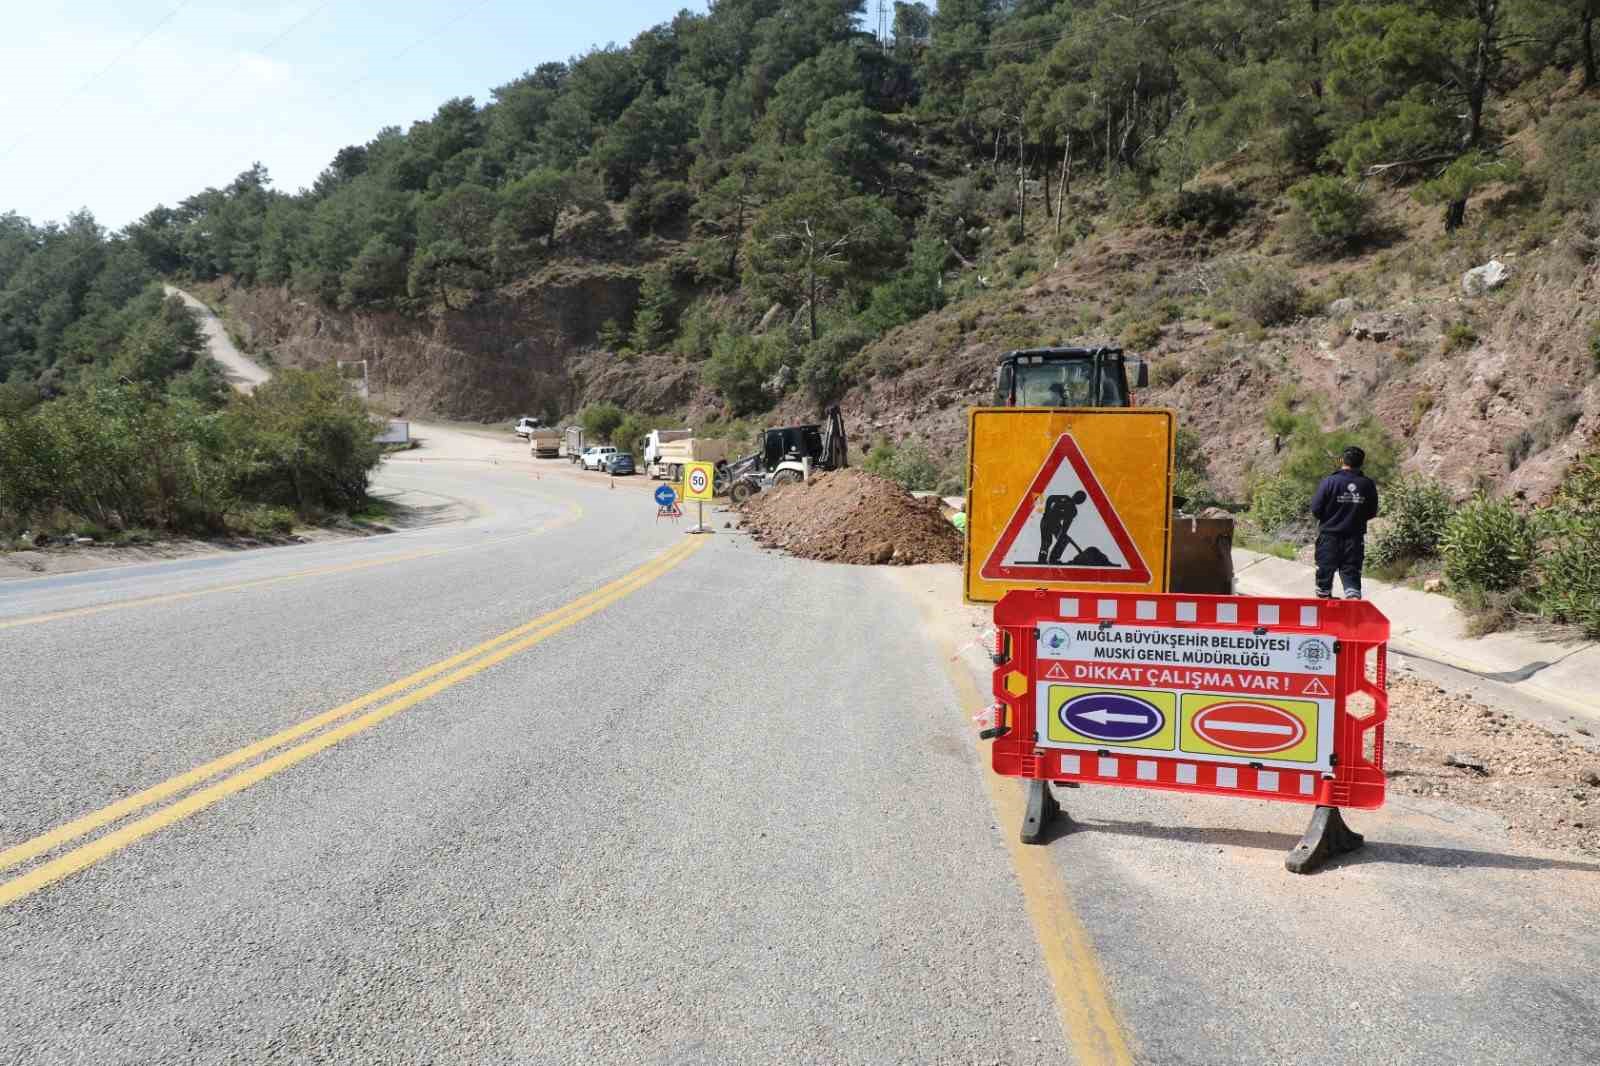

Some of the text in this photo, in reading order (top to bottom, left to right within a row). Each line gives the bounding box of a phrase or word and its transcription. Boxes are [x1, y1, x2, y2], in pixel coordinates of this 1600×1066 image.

[693, 476, 703, 486] 50
[1077, 627, 1122, 643] MUĞLA
[1125, 630, 1208, 648] BÜYÜKŞEHİR
[1211, 635, 1290, 651] BELEDİYESİ
[1094, 646, 1270, 666] MUSKİ GENEL MÜDÜRLÜĞÜ
[1075, 662, 1143, 681] DİKKAT
[1147, 669, 1235, 688] ÇALIŞMA
[1238, 674, 1280, 690] VAR
